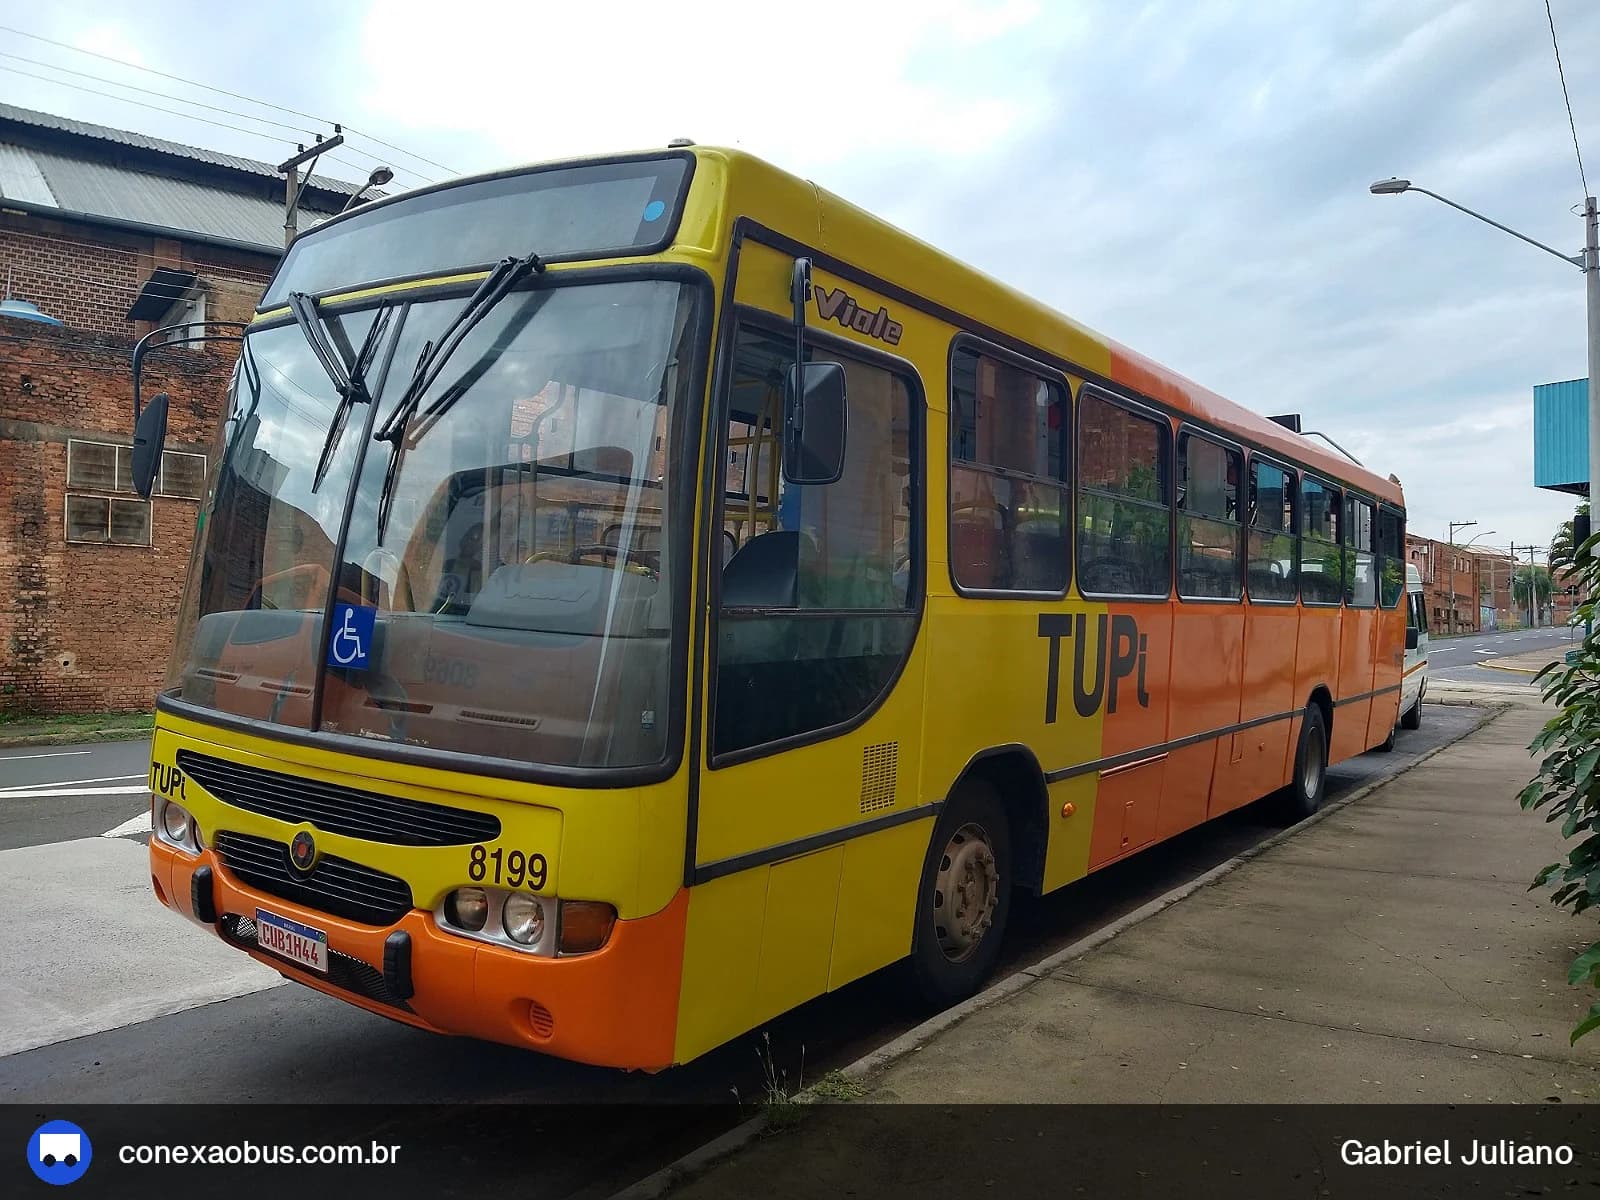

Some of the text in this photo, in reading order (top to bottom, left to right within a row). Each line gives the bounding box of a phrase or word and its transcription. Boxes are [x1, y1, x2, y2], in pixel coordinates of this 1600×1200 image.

[814, 284, 903, 346] Viale
[468, 844, 548, 891] 8199
[262, 923, 319, 965] CUB1H44
